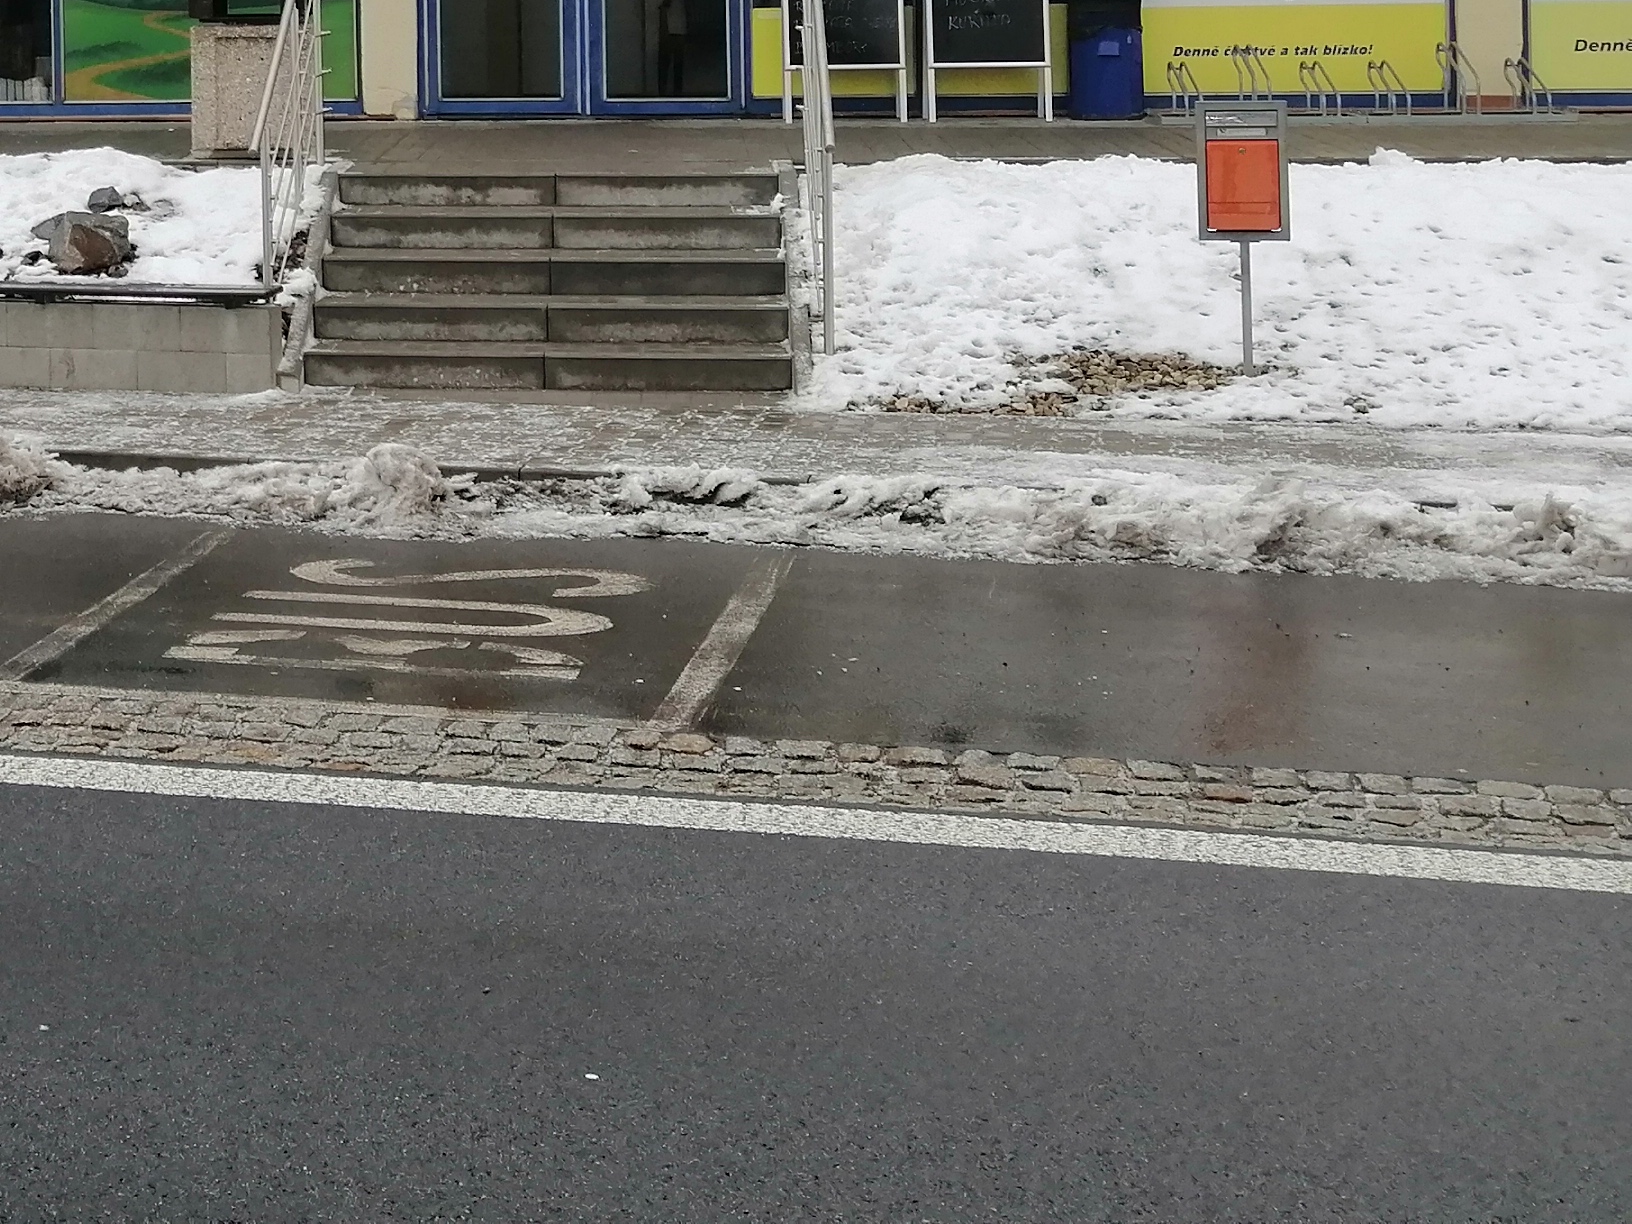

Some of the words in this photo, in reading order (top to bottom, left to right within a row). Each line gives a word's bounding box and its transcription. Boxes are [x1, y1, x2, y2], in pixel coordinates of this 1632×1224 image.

[1172, 45, 1219, 57] Denně
[1280, 47, 1288, 56] a
[1294, 45, 1317, 56] tak
[1323, 44, 1373, 55] blízko!
[161, 557, 652, 681] BUS
